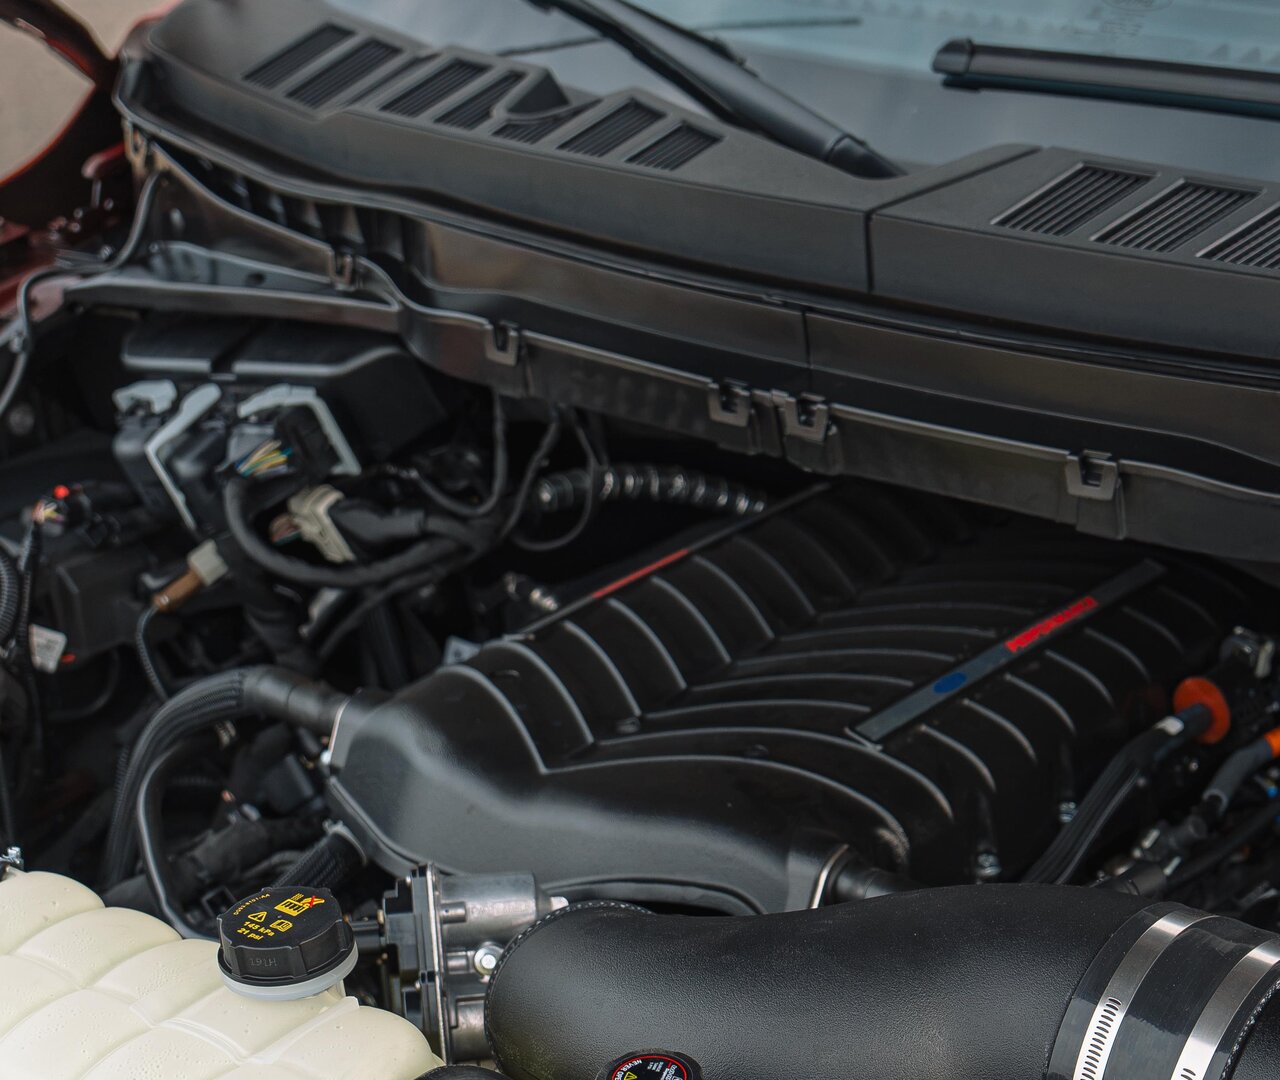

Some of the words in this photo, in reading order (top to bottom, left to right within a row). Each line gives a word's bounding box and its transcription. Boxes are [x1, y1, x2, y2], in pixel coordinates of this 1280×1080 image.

[244, 921, 260, 930] 145
[258, 926, 275, 936] kPa
[621, 1059, 642, 1072] NEVER
